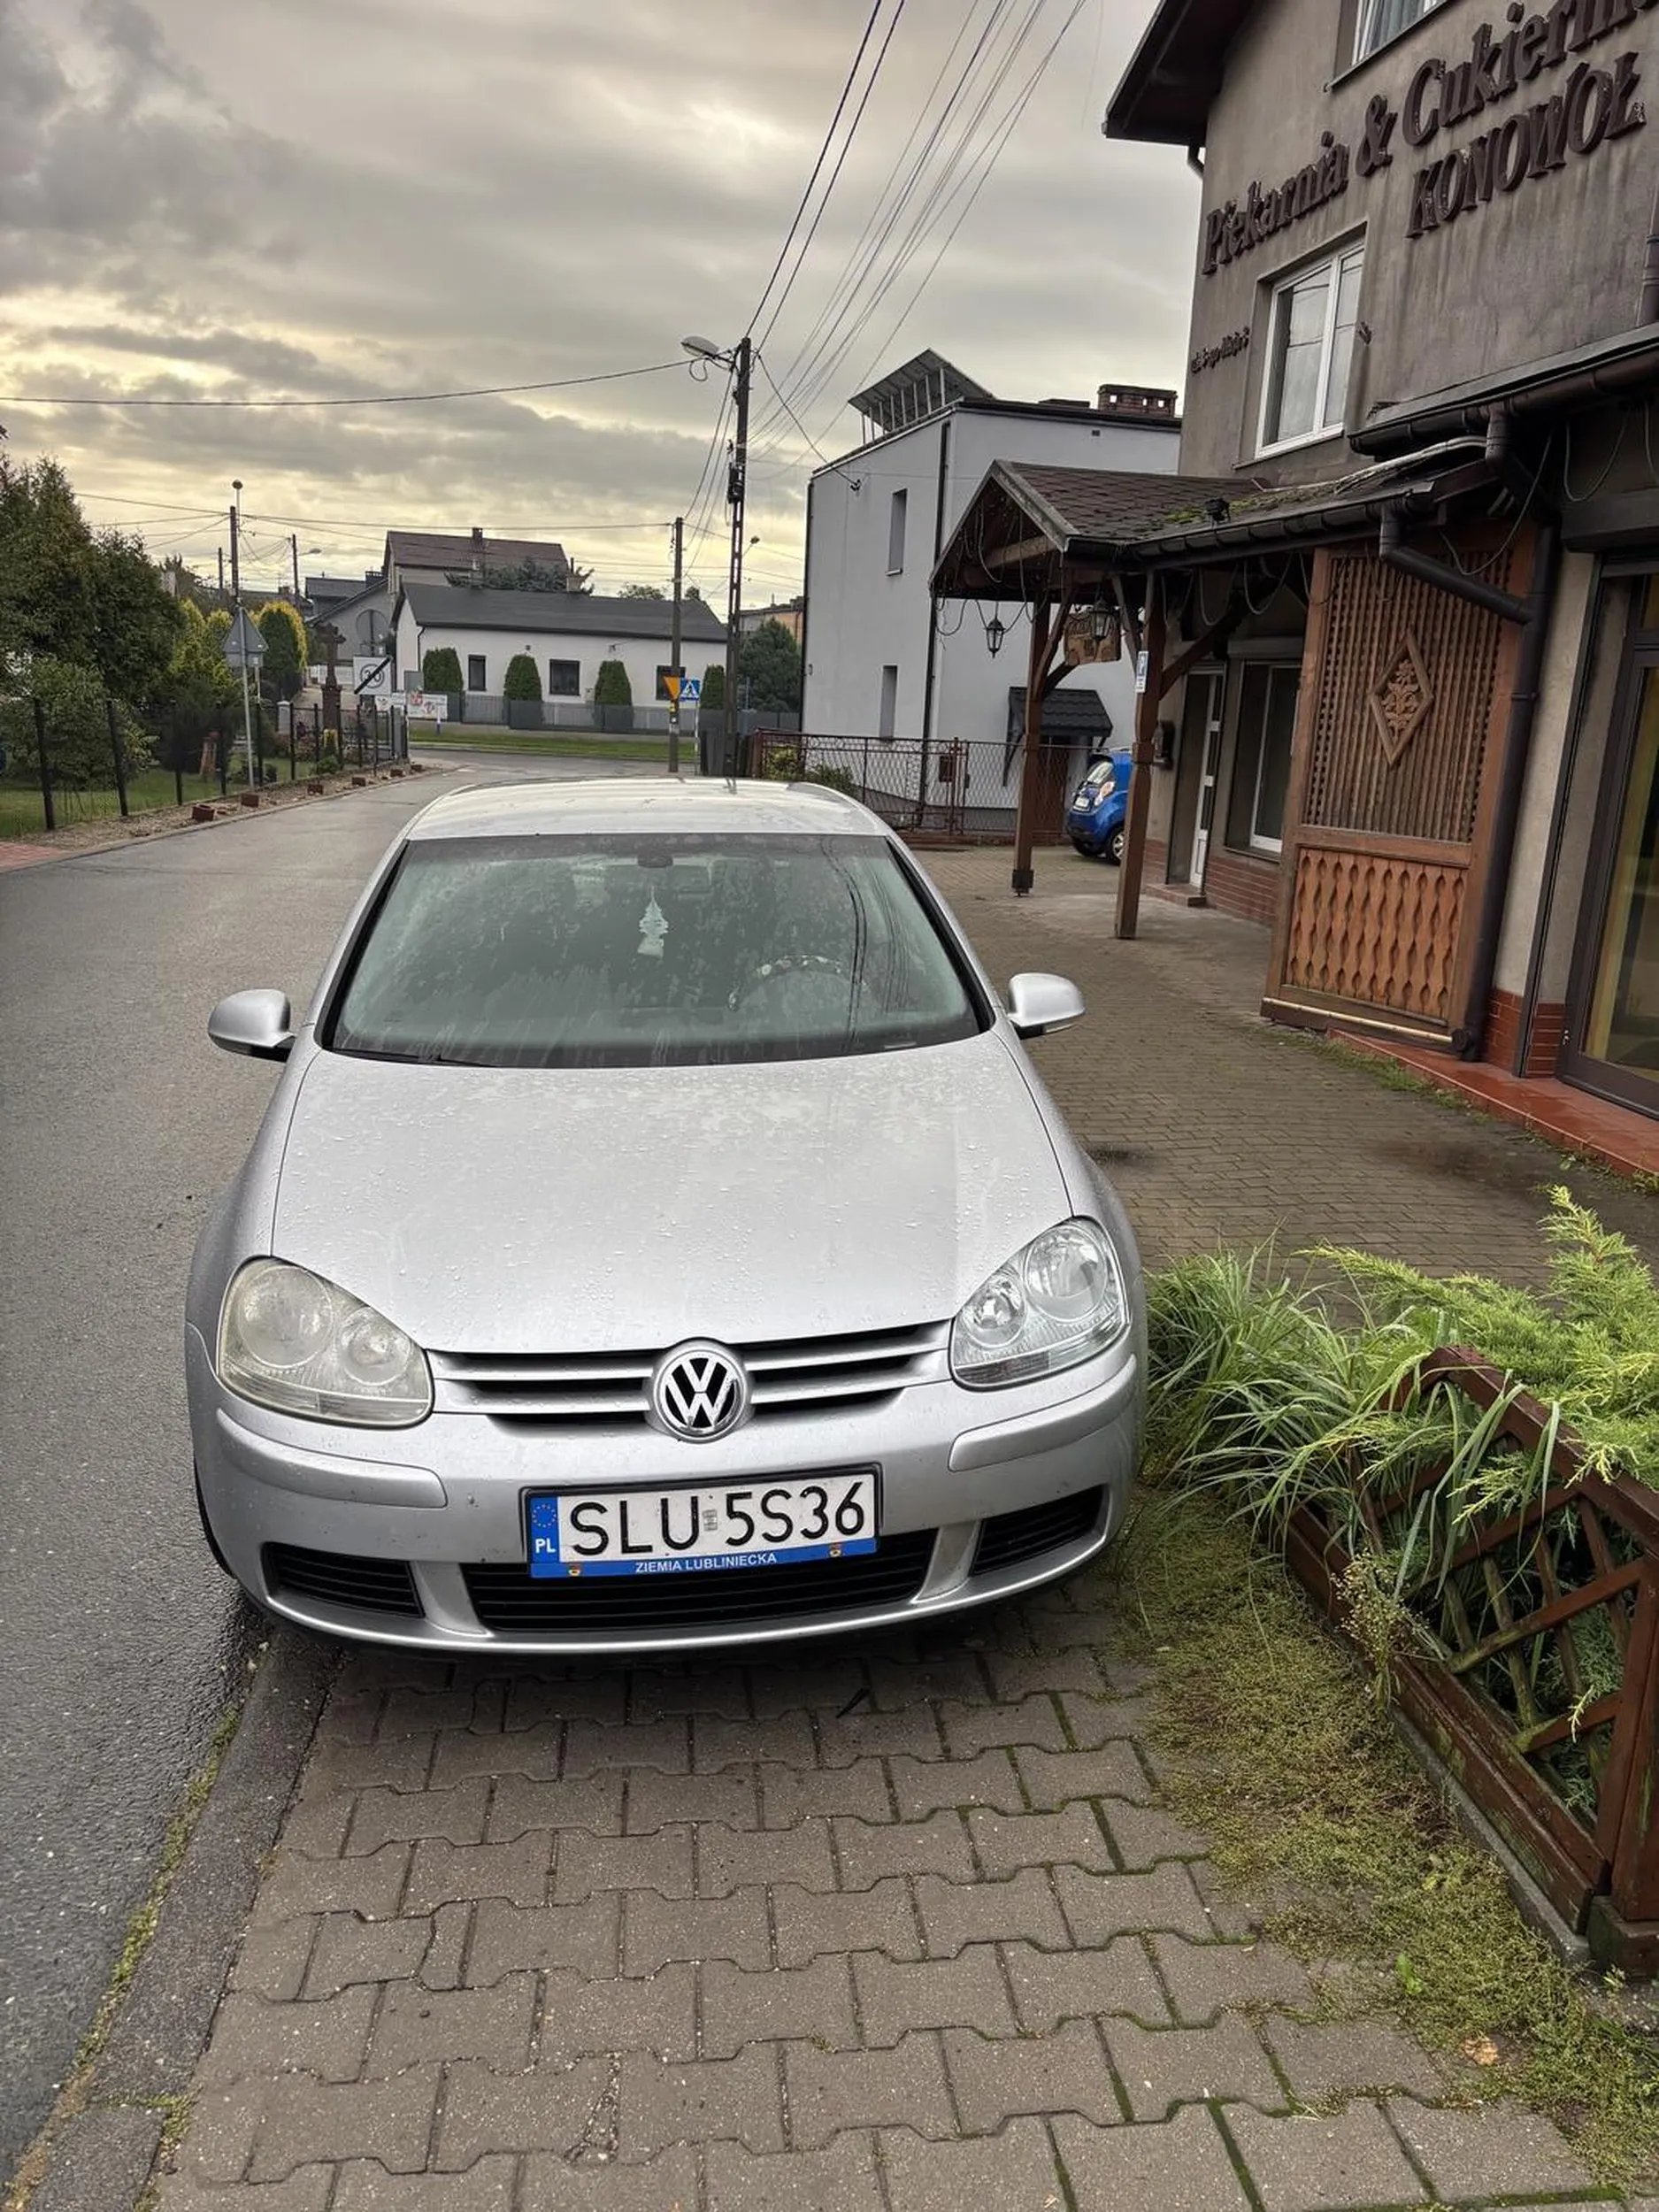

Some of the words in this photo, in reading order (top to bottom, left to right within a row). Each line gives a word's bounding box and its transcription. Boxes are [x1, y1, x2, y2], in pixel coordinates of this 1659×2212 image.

[1201, 131, 1351, 275] Piekarnia
[1356, 94, 1399, 177] &
[1402, 0, 1659, 147] Cukiern
[1405, 52, 1647, 239] KONOWOŁ
[535, 1538, 556, 1554] PL
[570, 1495, 699, 1556] SLU
[725, 1481, 864, 1548] 5S36
[635, 1560, 682, 1574] ZIEMIA
[686, 1552, 778, 1572] LUBLINIECKA
